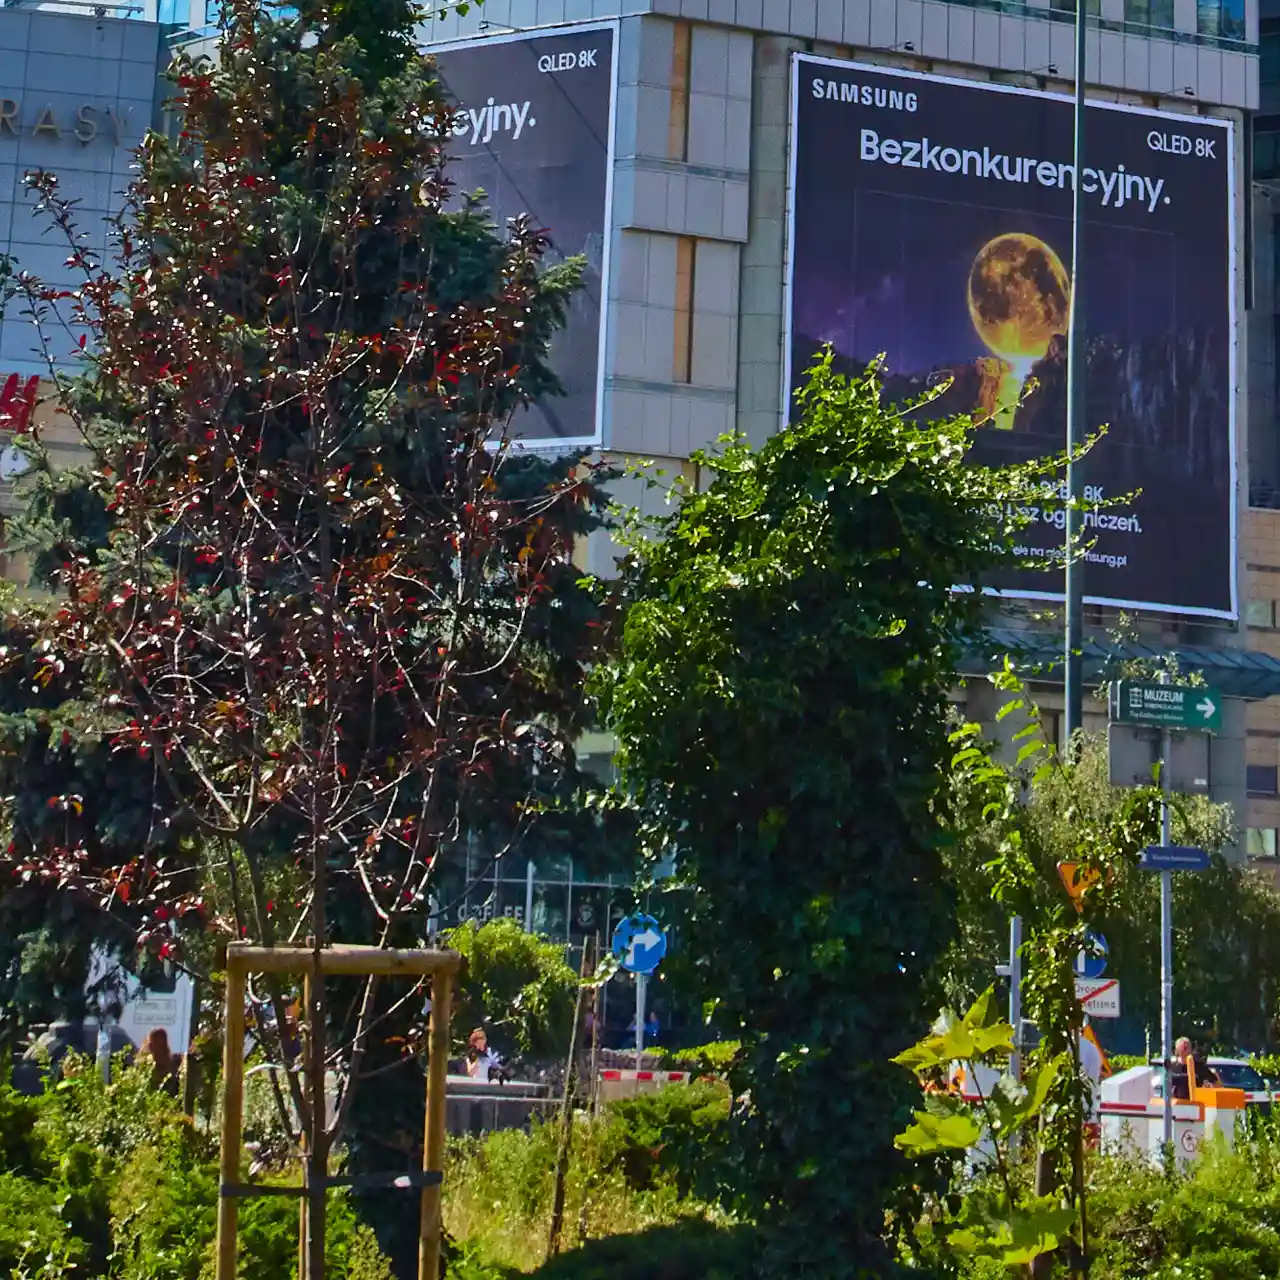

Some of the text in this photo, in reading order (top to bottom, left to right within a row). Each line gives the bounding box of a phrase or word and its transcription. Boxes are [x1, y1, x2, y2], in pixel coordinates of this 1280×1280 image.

[537, 49, 597, 73] QLED 8K
[812, 78, 918, 113] SAMSUNG
[1146, 130, 1217, 161] QLED 8K
[859, 128, 1172, 213] Bezkonkurencyjny.
[1083, 485, 1104, 503] 8K
[1042, 508, 1142, 533] ogniczeń.
[1143, 688, 1184, 703] MUZEUM
